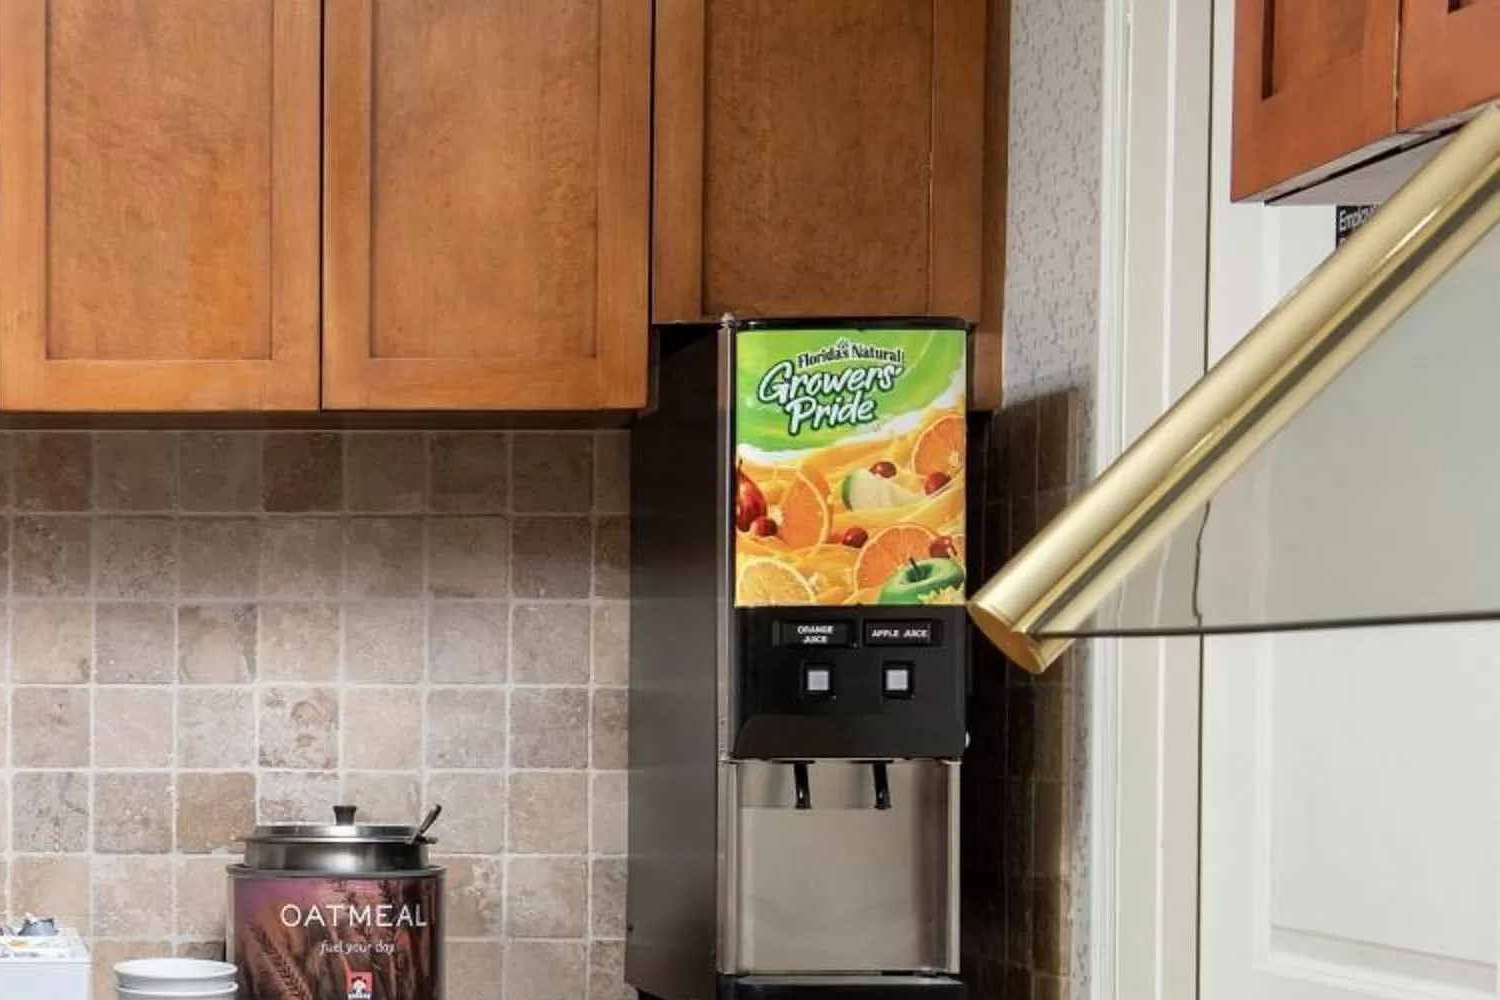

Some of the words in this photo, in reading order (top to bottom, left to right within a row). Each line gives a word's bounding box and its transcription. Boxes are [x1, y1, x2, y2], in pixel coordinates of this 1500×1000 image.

[850, 343, 902, 363] Natural
[784, 391, 876, 436] Pride
[797, 625, 834, 635] ORANGE
[871, 629, 900, 638] APPLE
[902, 629, 928, 638] JUICE
[803, 635, 829, 645] JUICE
[279, 903, 428, 928] OATMEAL
[320, 940, 344, 957] fuel
[345, 943, 373, 956] your
[375, 940, 395, 957] day
